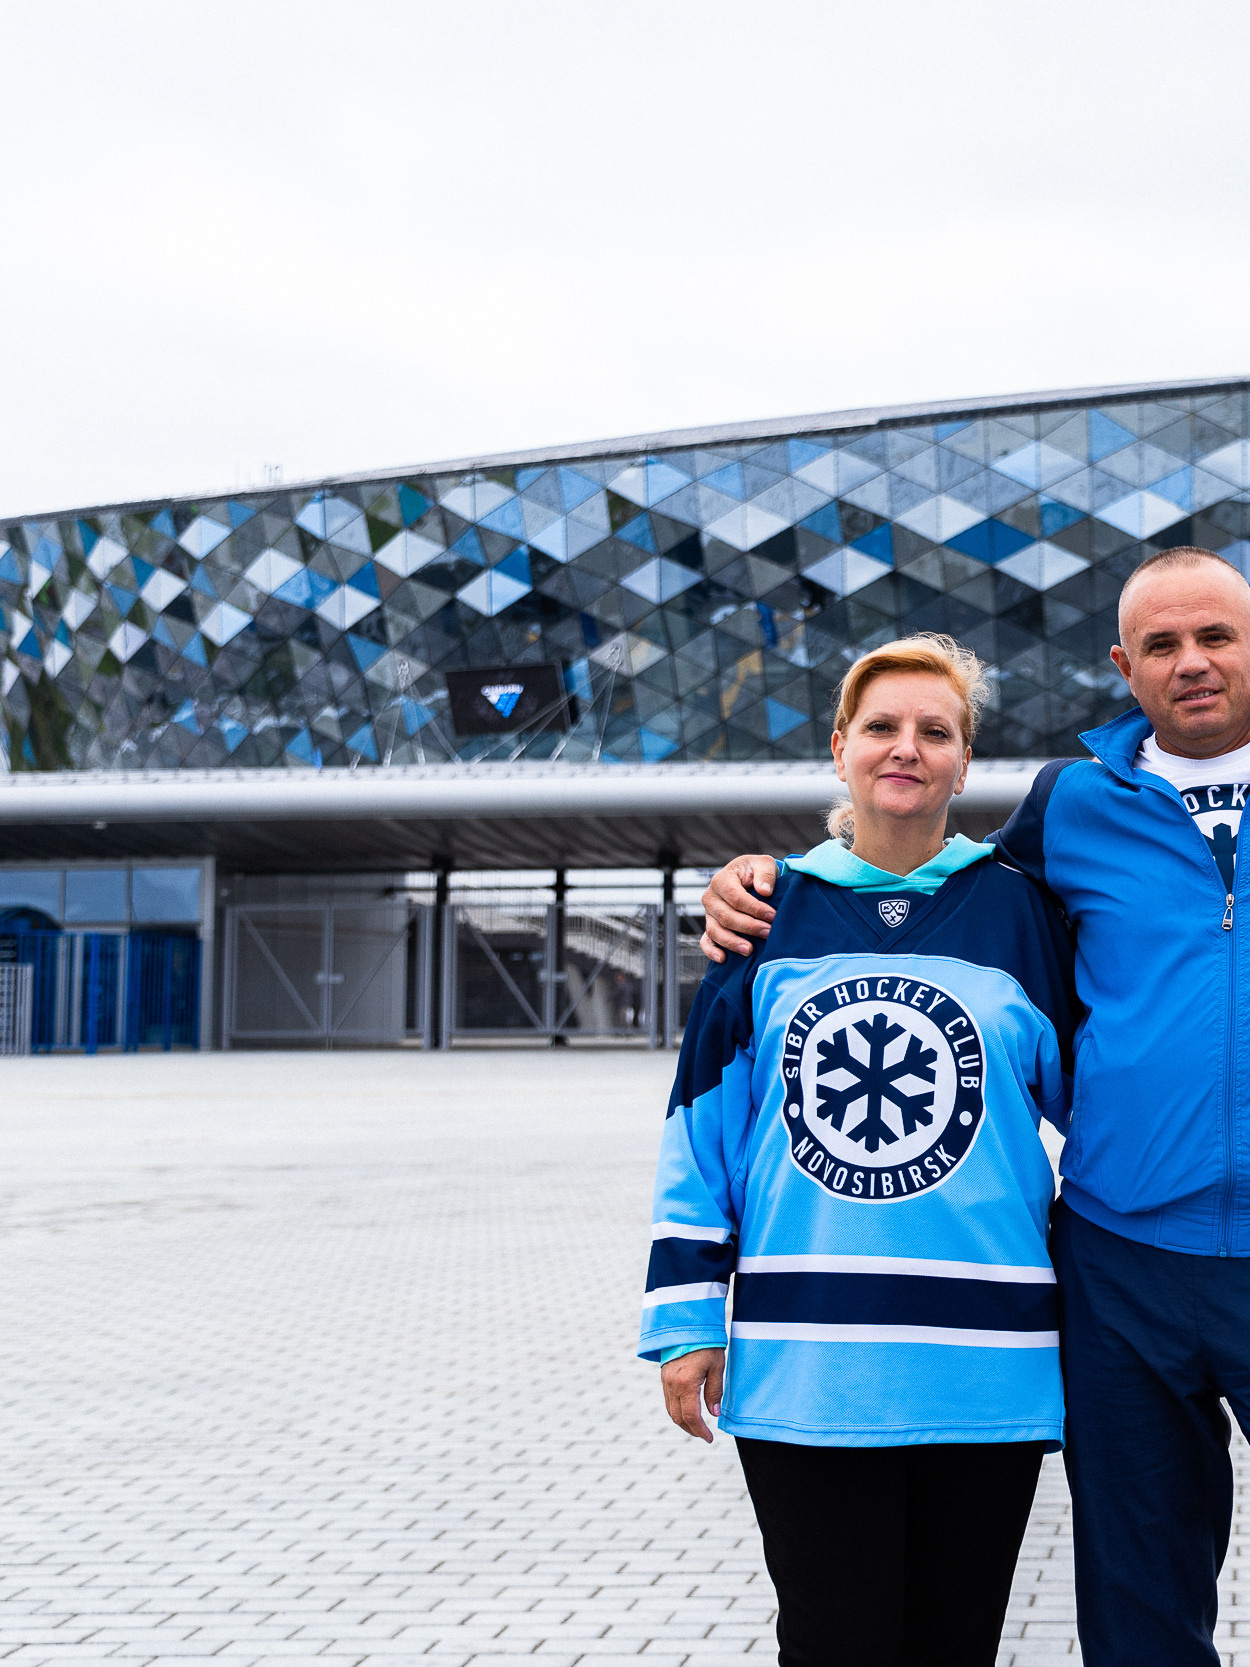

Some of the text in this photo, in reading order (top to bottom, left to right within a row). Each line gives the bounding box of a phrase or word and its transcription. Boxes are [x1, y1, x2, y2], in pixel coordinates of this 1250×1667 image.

[785, 978, 980, 1090] SIBIR HOCKEY CLUB
[793, 1136, 957, 1197] NOVOSIBIRSK
